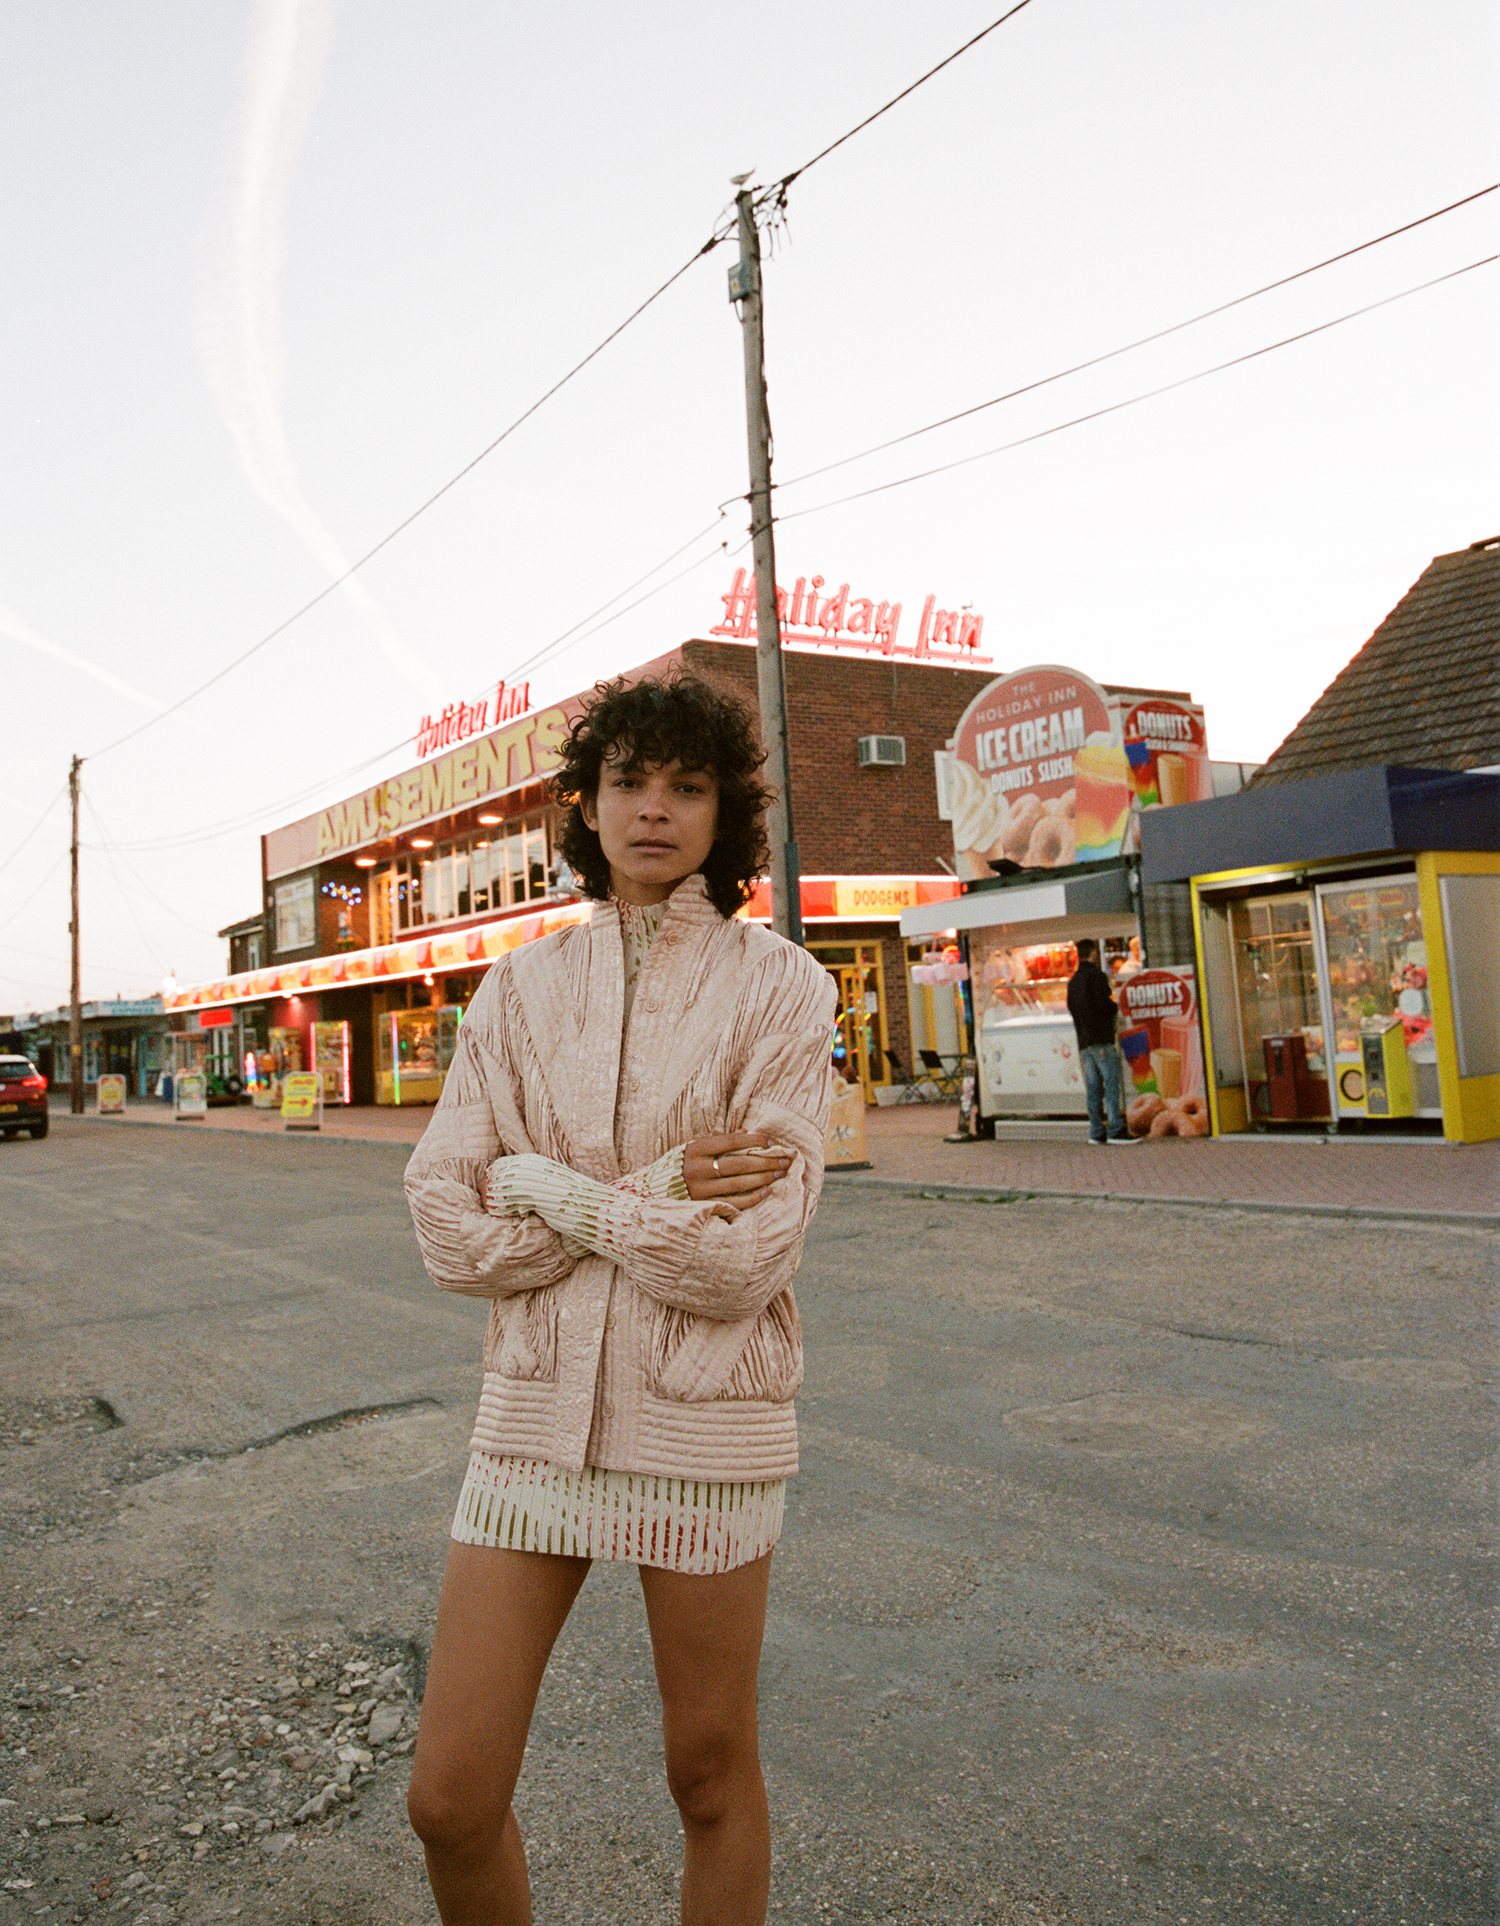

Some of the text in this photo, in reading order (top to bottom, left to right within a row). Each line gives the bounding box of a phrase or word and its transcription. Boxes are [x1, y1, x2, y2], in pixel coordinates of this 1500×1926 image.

[914, 594, 985, 658] Inn
[975, 684, 1078, 724] HOLIDAY INN
[1012, 681, 1036, 696] THE
[975, 706, 1086, 773] ICE CREAM
[1136, 710, 1193, 741] DONUTS
[316, 708, 569, 857] AMUSEMENTS
[991, 755, 1076, 795] DONUTS SLUSH
[853, 889, 910, 906] DODGEMS
[1126, 981, 1184, 1008] DONUTS
